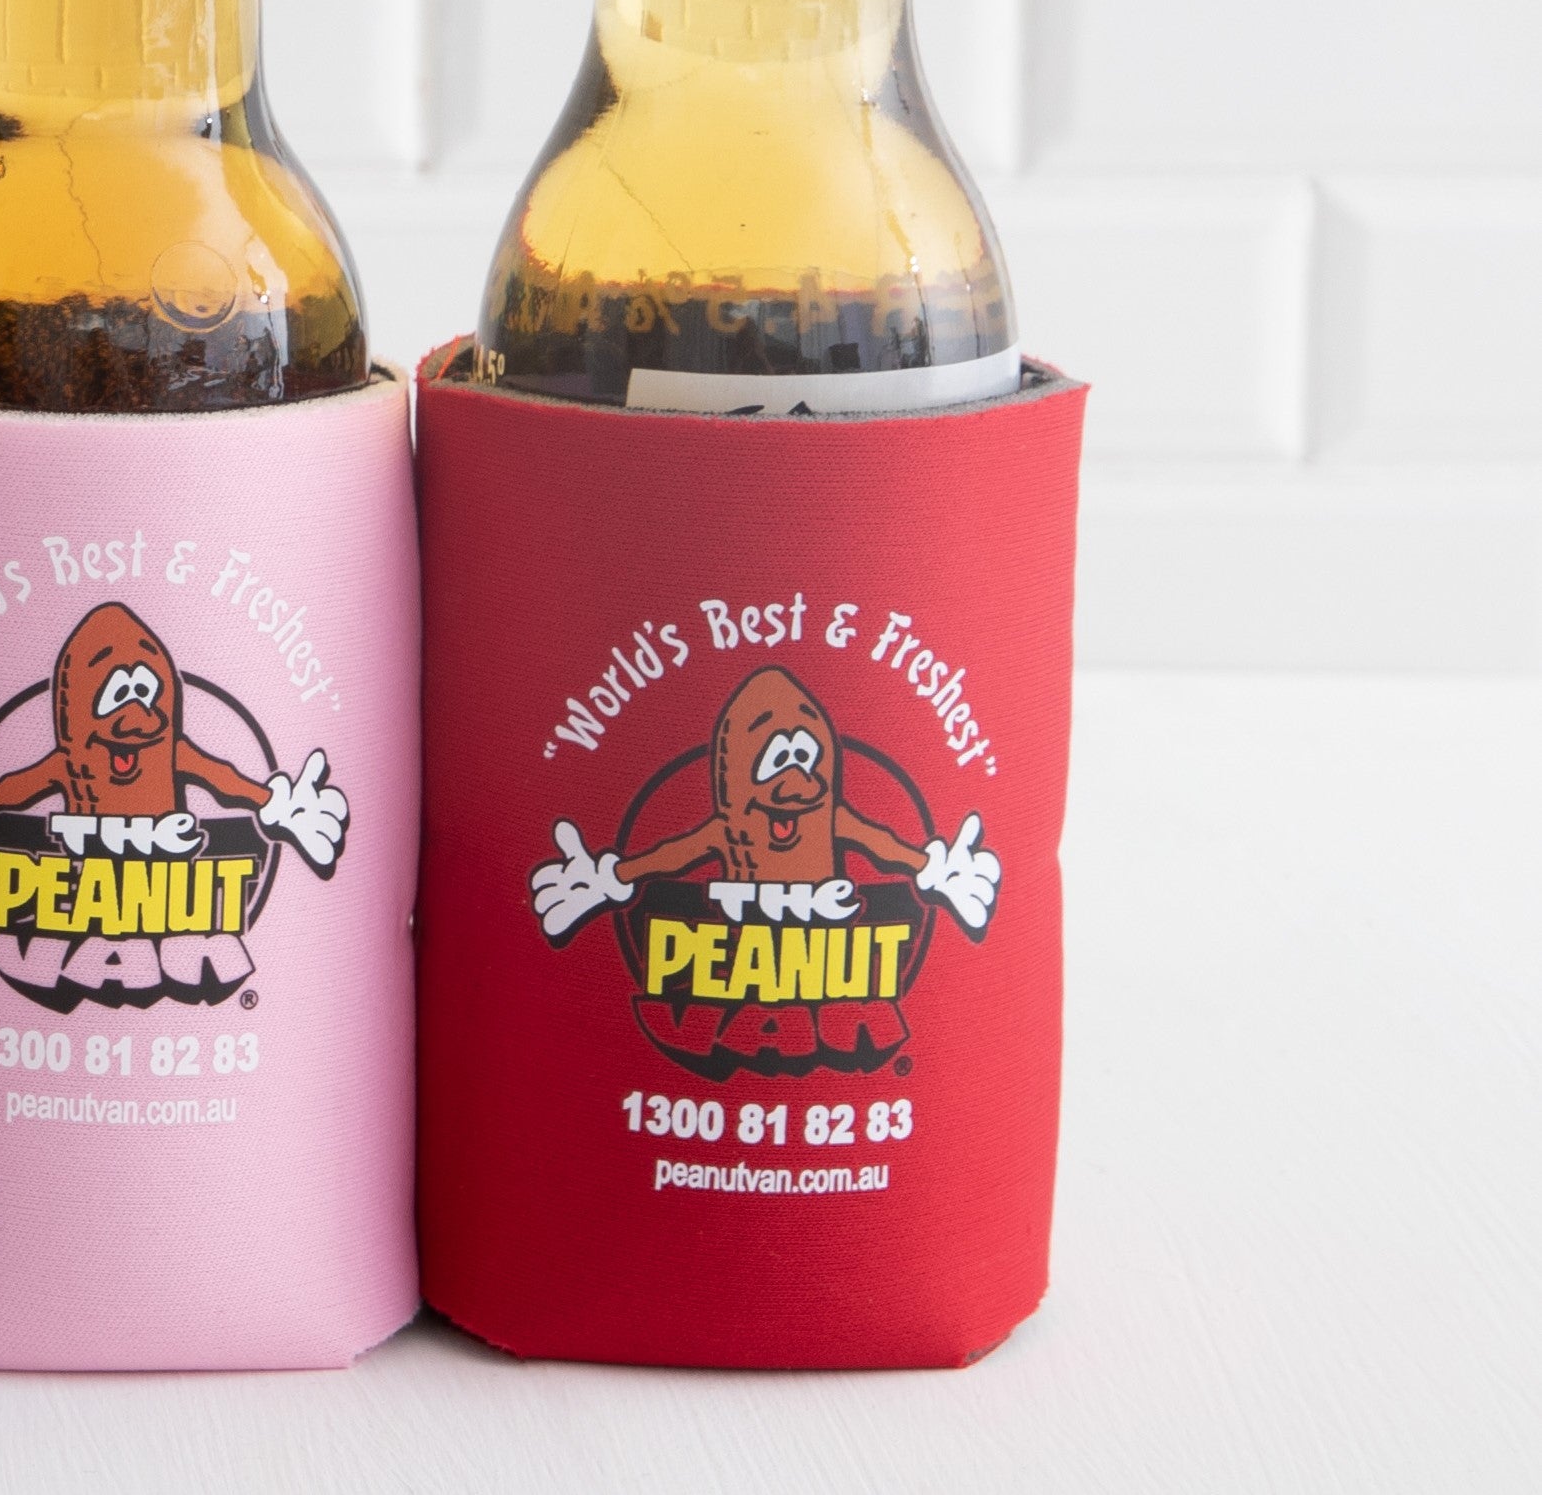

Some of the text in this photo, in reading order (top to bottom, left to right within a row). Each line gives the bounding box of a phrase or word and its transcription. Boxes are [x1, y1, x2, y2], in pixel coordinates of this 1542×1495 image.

[42, 530, 147, 586] Best
[166, 541, 197, 584] &
[700, 592, 806, 649] Best
[825, 603, 858, 648] &
[647, 918, 910, 1002] PEANUT
[85, 1035, 132, 1075] 81
[150, 1036, 200, 1076] 82
[213, 1033, 259, 1072] 83
[6, 1091, 236, 1125] peanutvan.com.au
[622, 1091, 912, 1145] 1300 81 82 83
[655, 1159, 888, 1194] peanutvan.com.au
